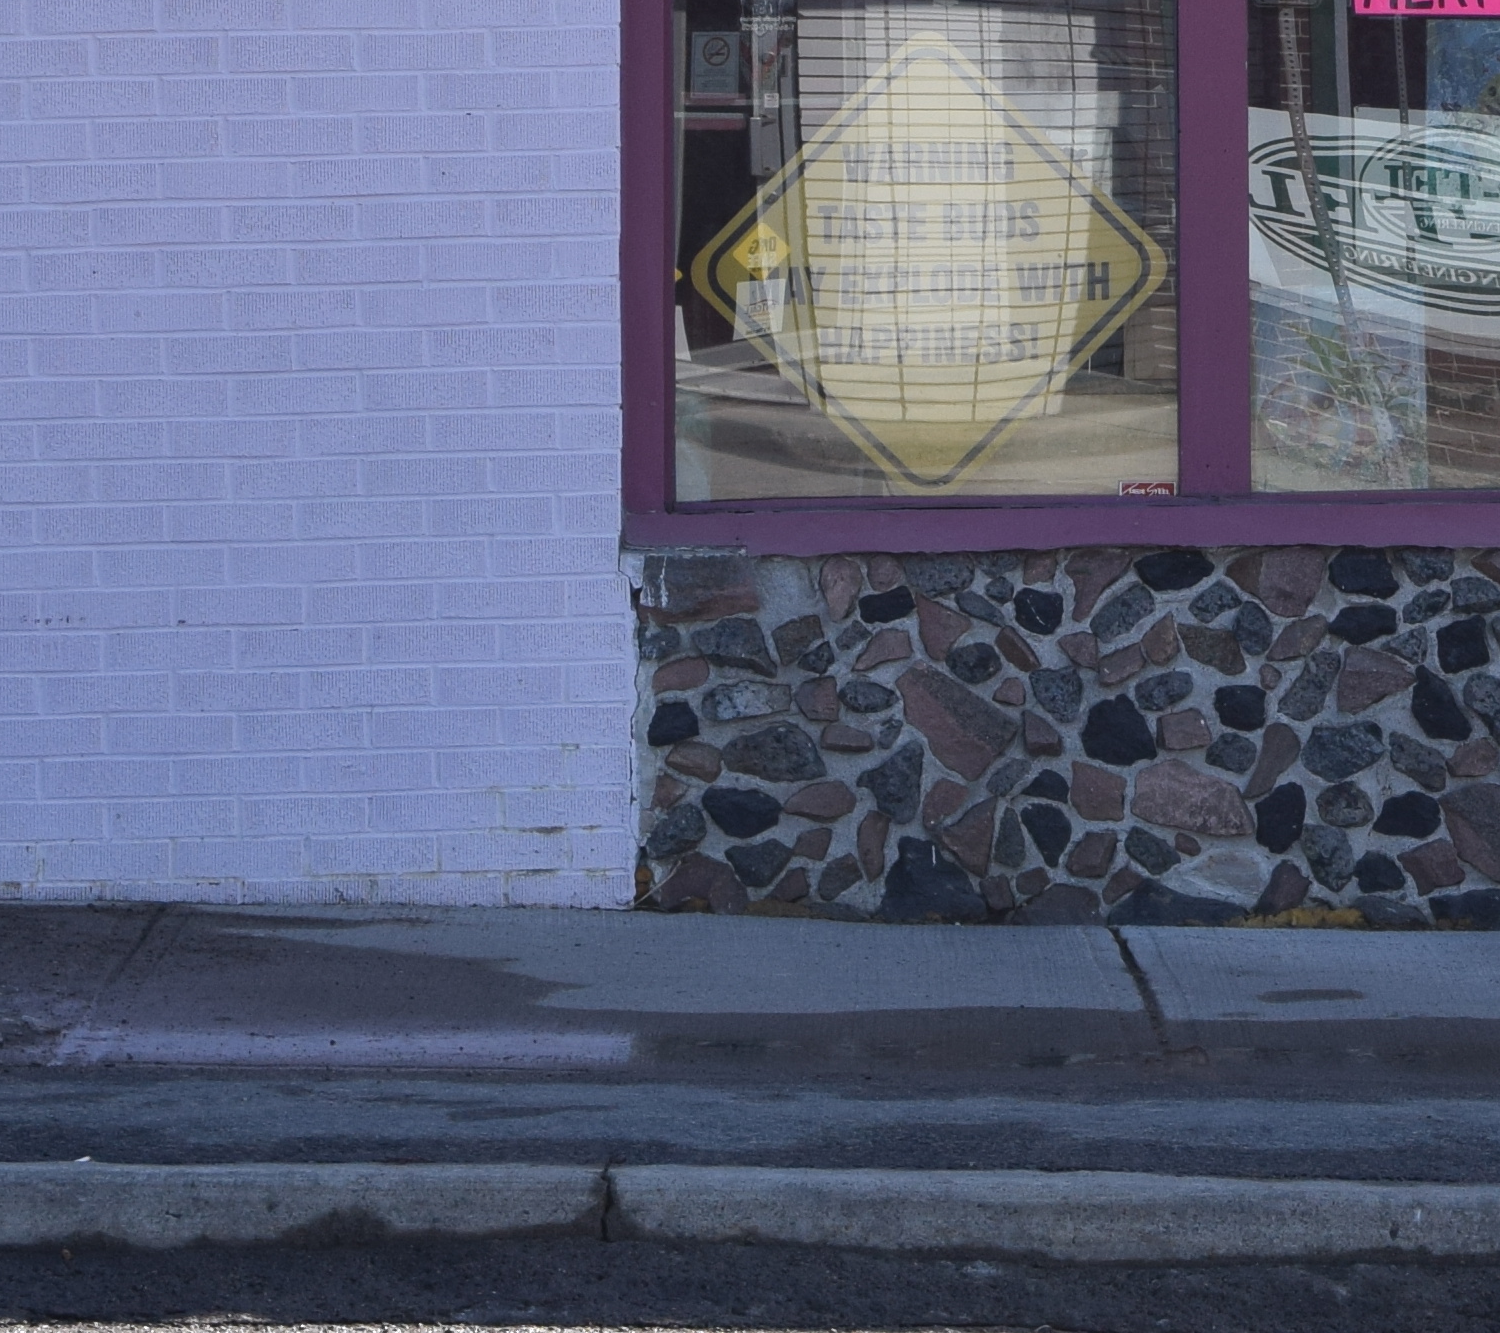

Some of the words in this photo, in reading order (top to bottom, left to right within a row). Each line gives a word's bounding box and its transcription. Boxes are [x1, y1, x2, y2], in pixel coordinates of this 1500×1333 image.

[842, 141, 1016, 183] WARNING
[817, 203, 928, 246] TASTE
[941, 201, 1041, 242] BUDS
[749, 263, 827, 307] MAY
[843, 263, 1001, 307] EXPLODE
[1016, 261, 1110, 303] WITH
[818, 321, 1040, 367] HAPPINESS!
